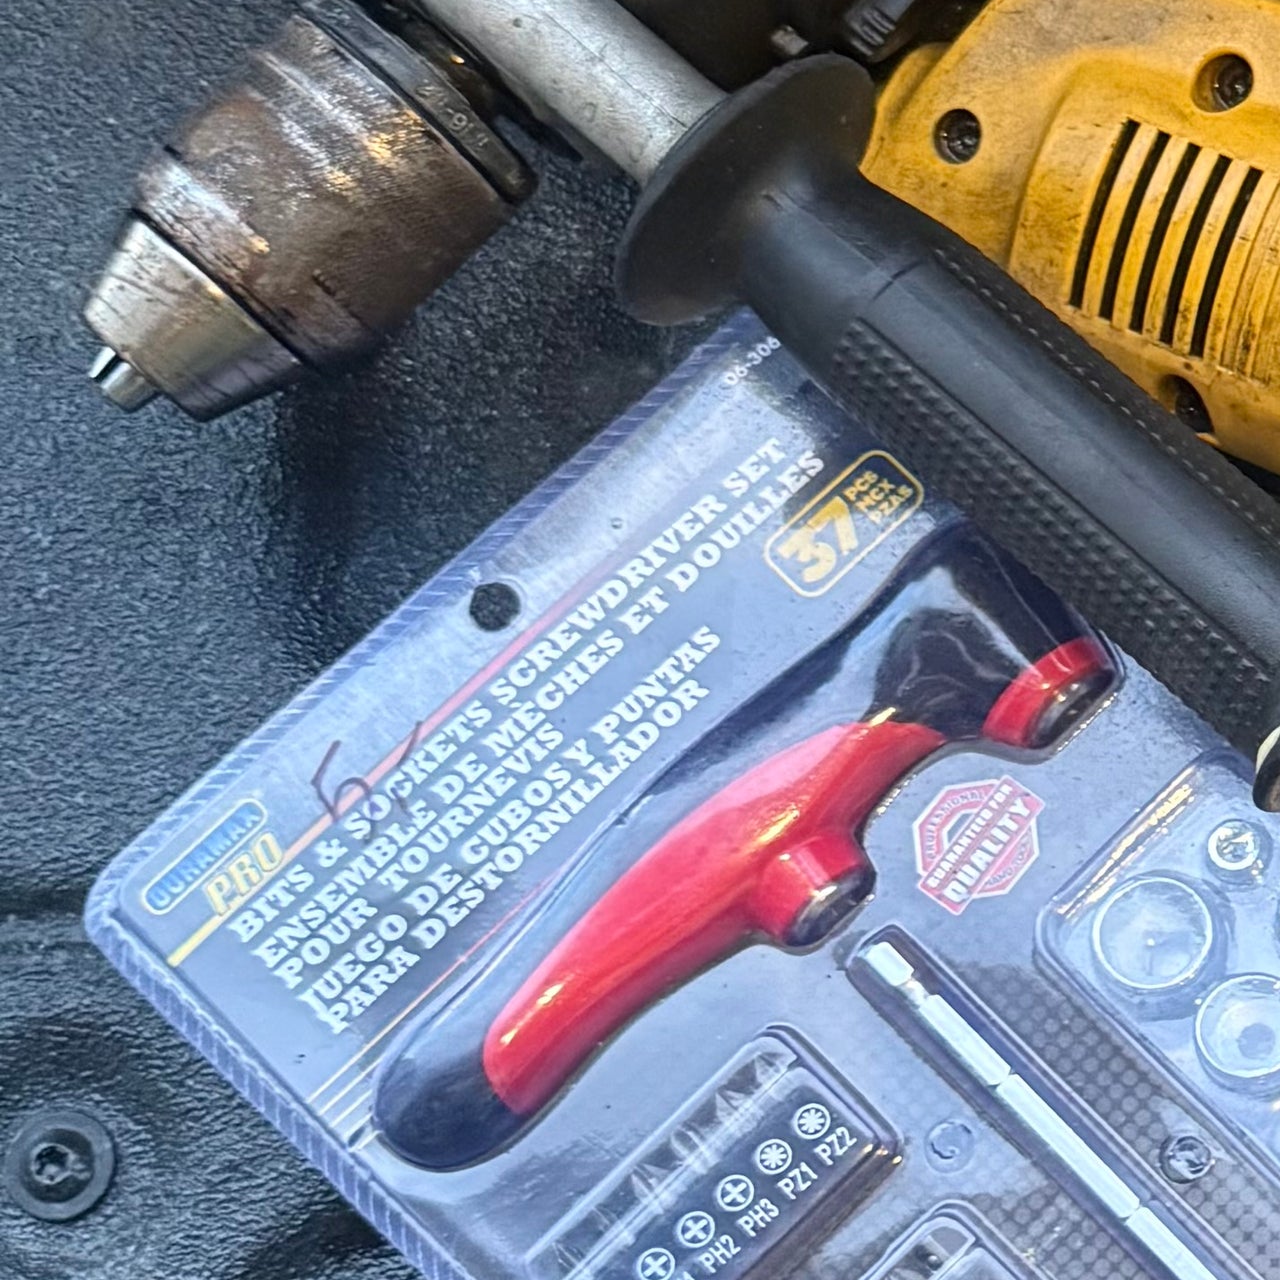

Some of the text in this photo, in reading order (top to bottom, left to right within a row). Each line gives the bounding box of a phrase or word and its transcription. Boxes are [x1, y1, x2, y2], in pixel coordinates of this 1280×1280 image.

[722, 335, 782, 388] 06-306
[776, 495, 859, 584] 37
[842, 469, 879, 503] PCS
[867, 485, 914, 525] PZAS
[227, 437, 786, 943] BITS & SOCKETS SCREWDRIVER SET
[251, 449, 825, 968] ENSEMBLE DE MÈCHES ET DOUILLES
[204, 831, 285, 917] PRO
[272, 721, 565, 990] POUR TOURNEVIS
[297, 625, 722, 1023] JUEGO DE CUBOS Y PUNTAS
[314, 677, 712, 1035] PARA DESTORNILLADOR
[925, 783, 1014, 889] GUARANTEED FOR
[942, 797, 1031, 904] QUALITY
[699, 1233, 742, 1275] PH2
[736, 1197, 780, 1238] PH3
[776, 1161, 819, 1201] PZ1
[813, 1125, 858, 1166] PZ2
